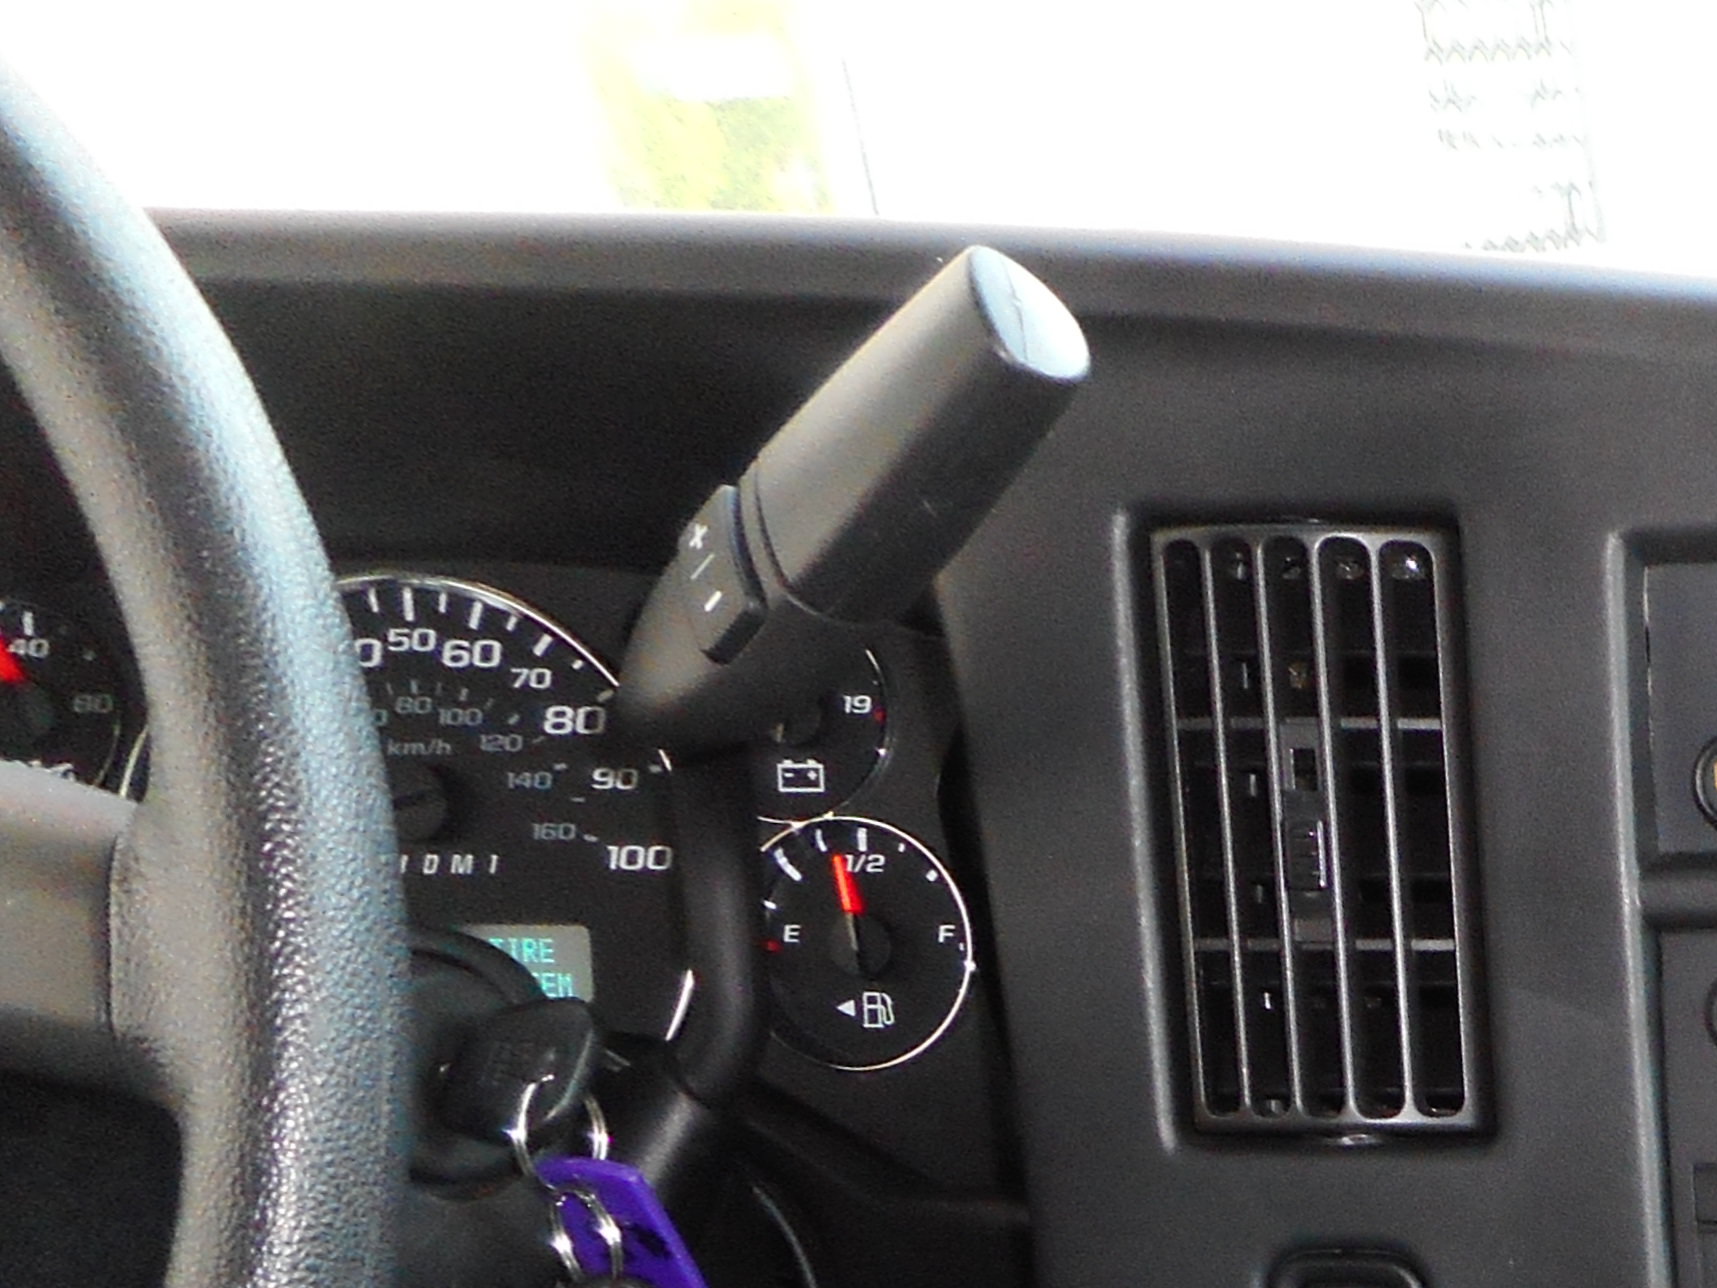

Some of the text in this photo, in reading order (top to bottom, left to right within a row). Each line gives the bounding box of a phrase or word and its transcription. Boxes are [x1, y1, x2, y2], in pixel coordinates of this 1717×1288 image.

[387, 628, 437, 652] 50
[354, 638, 383, 667] 0
[441, 639, 502, 668] 60
[510, 667, 552, 689] 70
[843, 694, 872, 714] 19
[437, 707, 484, 728] 100
[543, 705, 607, 735] 80
[386, 738, 452, 755] km/h
[479, 733, 523, 752] 120
[507, 771, 553, 789] 140
[591, 767, 639, 790] 90
[532, 822, 577, 841] 160
[605, 844, 673, 872] 100
[846, 854, 886, 873] 1/2
[783, 924, 801, 943] E
[938, 924, 956, 943] F
